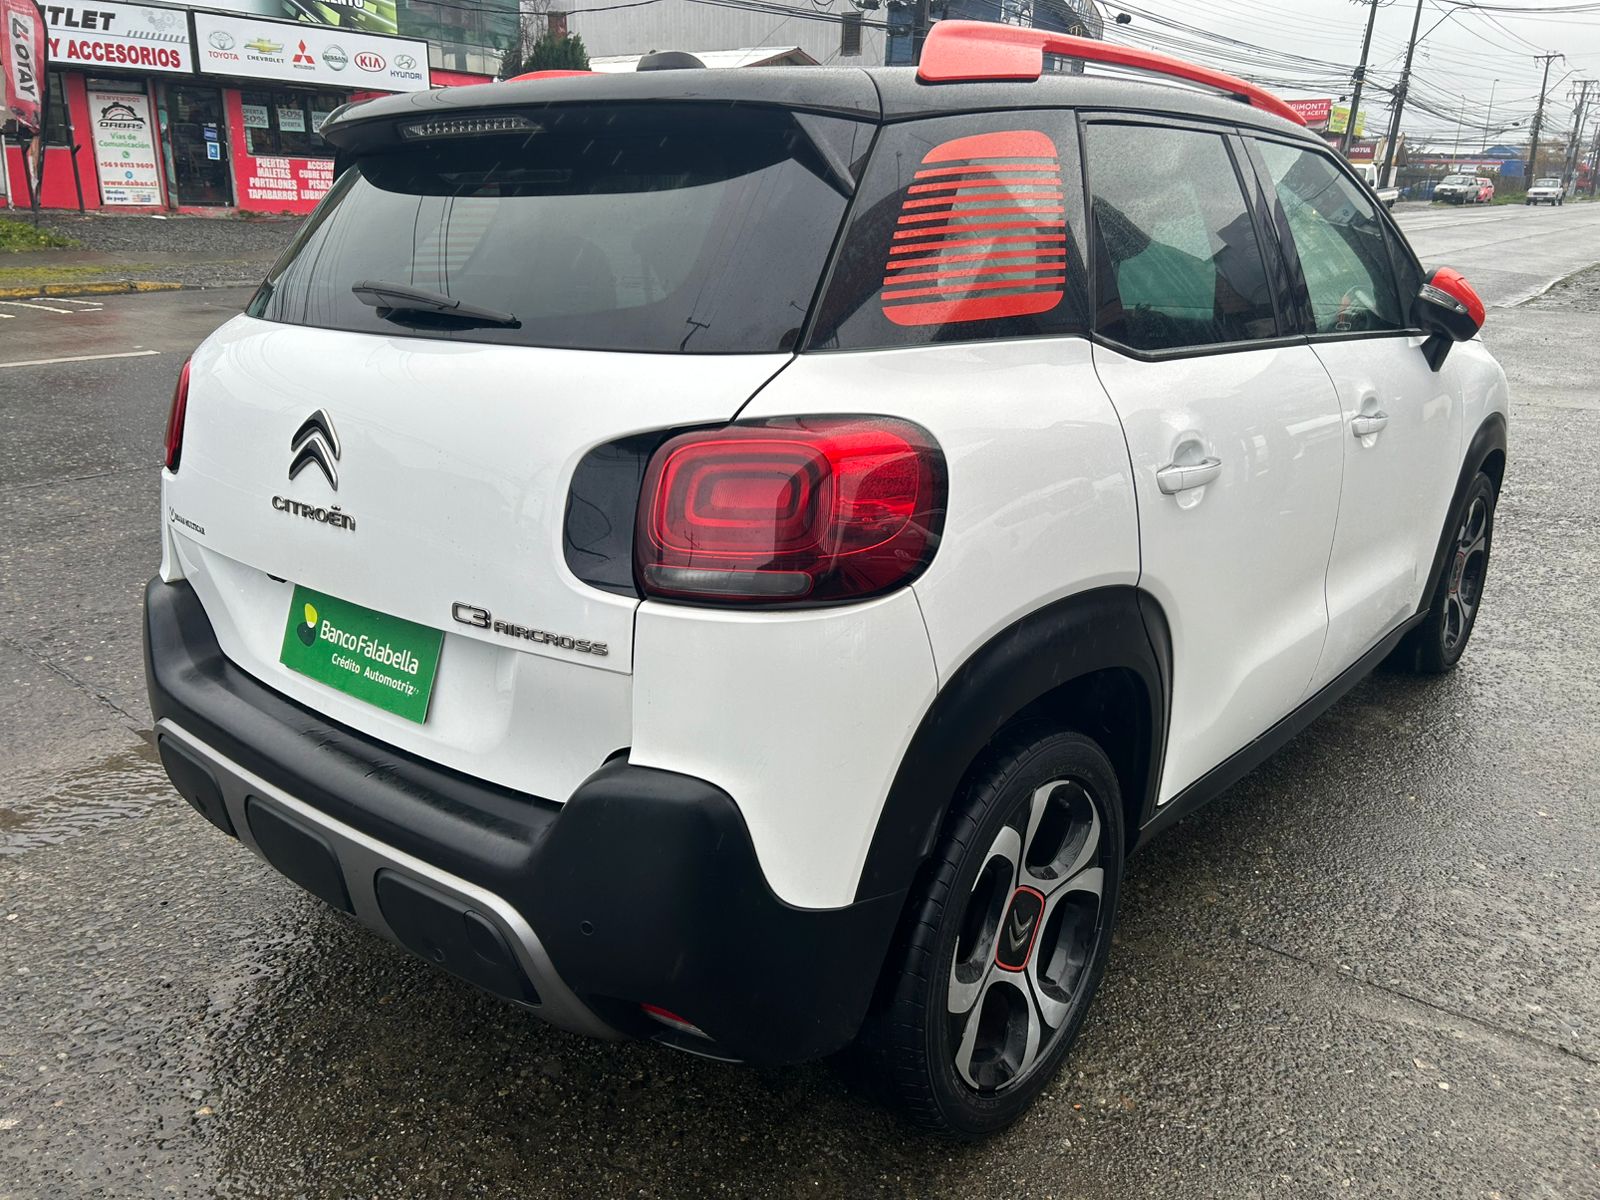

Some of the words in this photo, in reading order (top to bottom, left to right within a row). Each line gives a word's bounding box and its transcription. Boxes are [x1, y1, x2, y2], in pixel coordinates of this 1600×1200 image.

[43, 4, 116, 31] TLET
[48, 37, 60, 57] Y
[67, 39, 181, 68] ACCESORIOS
[208, 50, 239, 61] TOYOTA
[246, 54, 284, 64] CHEVROLET
[360, 55, 381, 69] KIA
[390, 70, 423, 80] HYUNDAI
[100, 121, 144, 130] DABAS
[256, 158, 290, 169] PUERTAS
[256, 168, 291, 179] MALETAS
[249, 177, 297, 190] PORTALONES
[247, 189, 298, 200] TAPABARROS
[451, 601, 492, 630] C3
[493, 619, 609, 657] AIRCROSS
[320, 619, 358, 651] Banco
[356, 634, 419, 675] Falabella
[331, 652, 361, 674] Crédito
